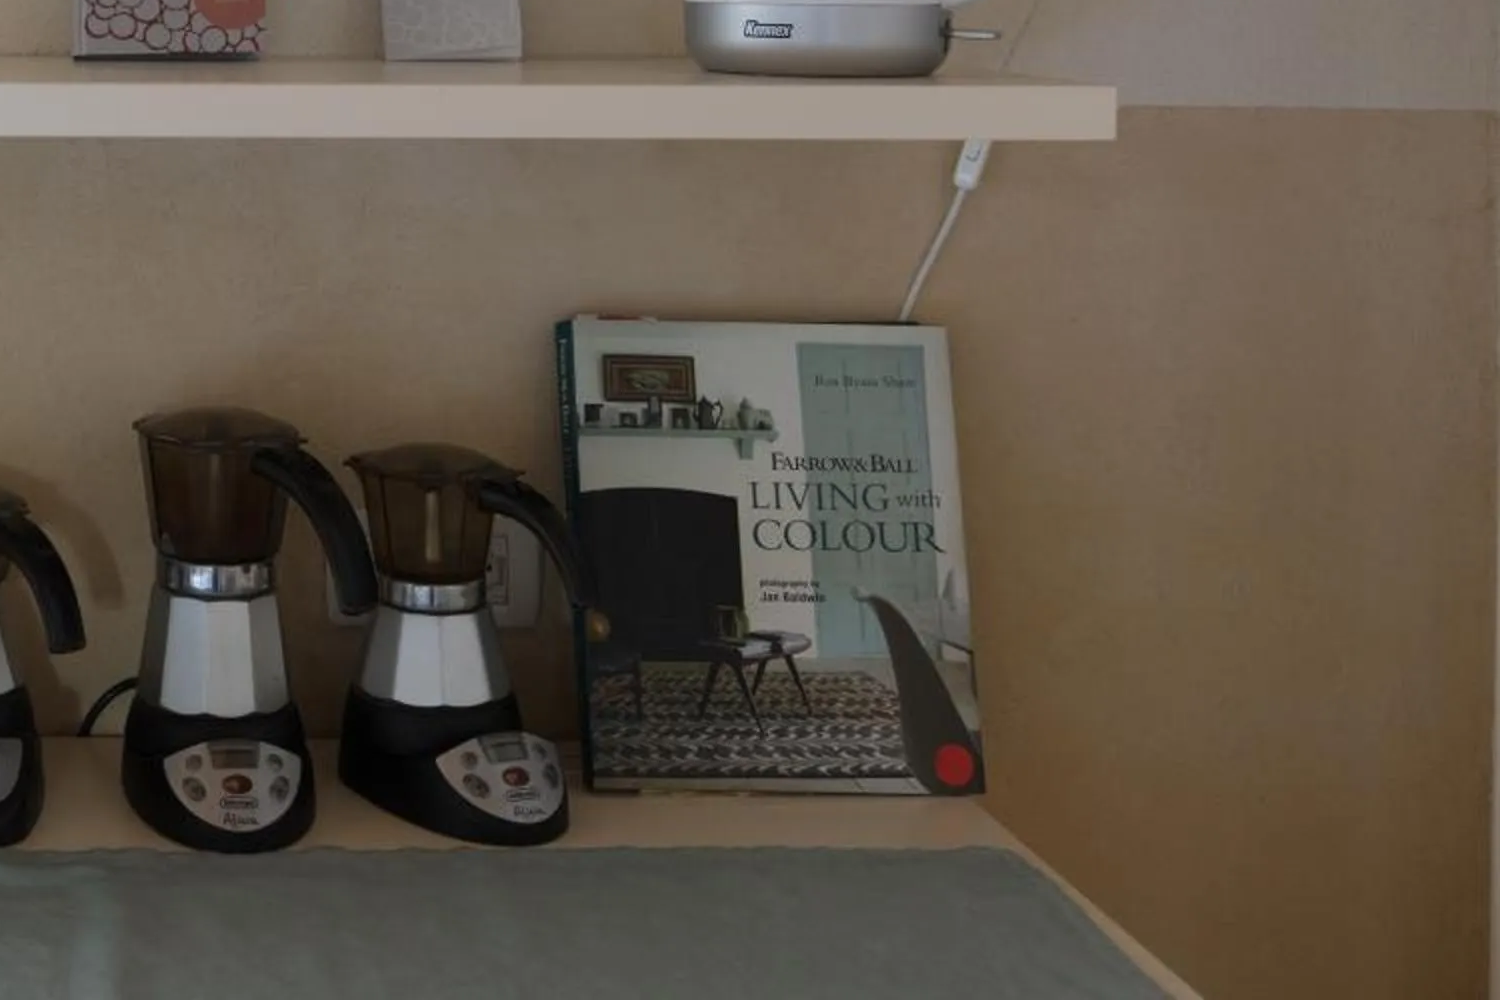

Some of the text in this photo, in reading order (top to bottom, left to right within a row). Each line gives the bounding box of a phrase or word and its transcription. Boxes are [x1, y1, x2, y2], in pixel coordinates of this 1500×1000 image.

[750, 481, 942, 511] LIVING with
[752, 518, 947, 554] COLOUR
